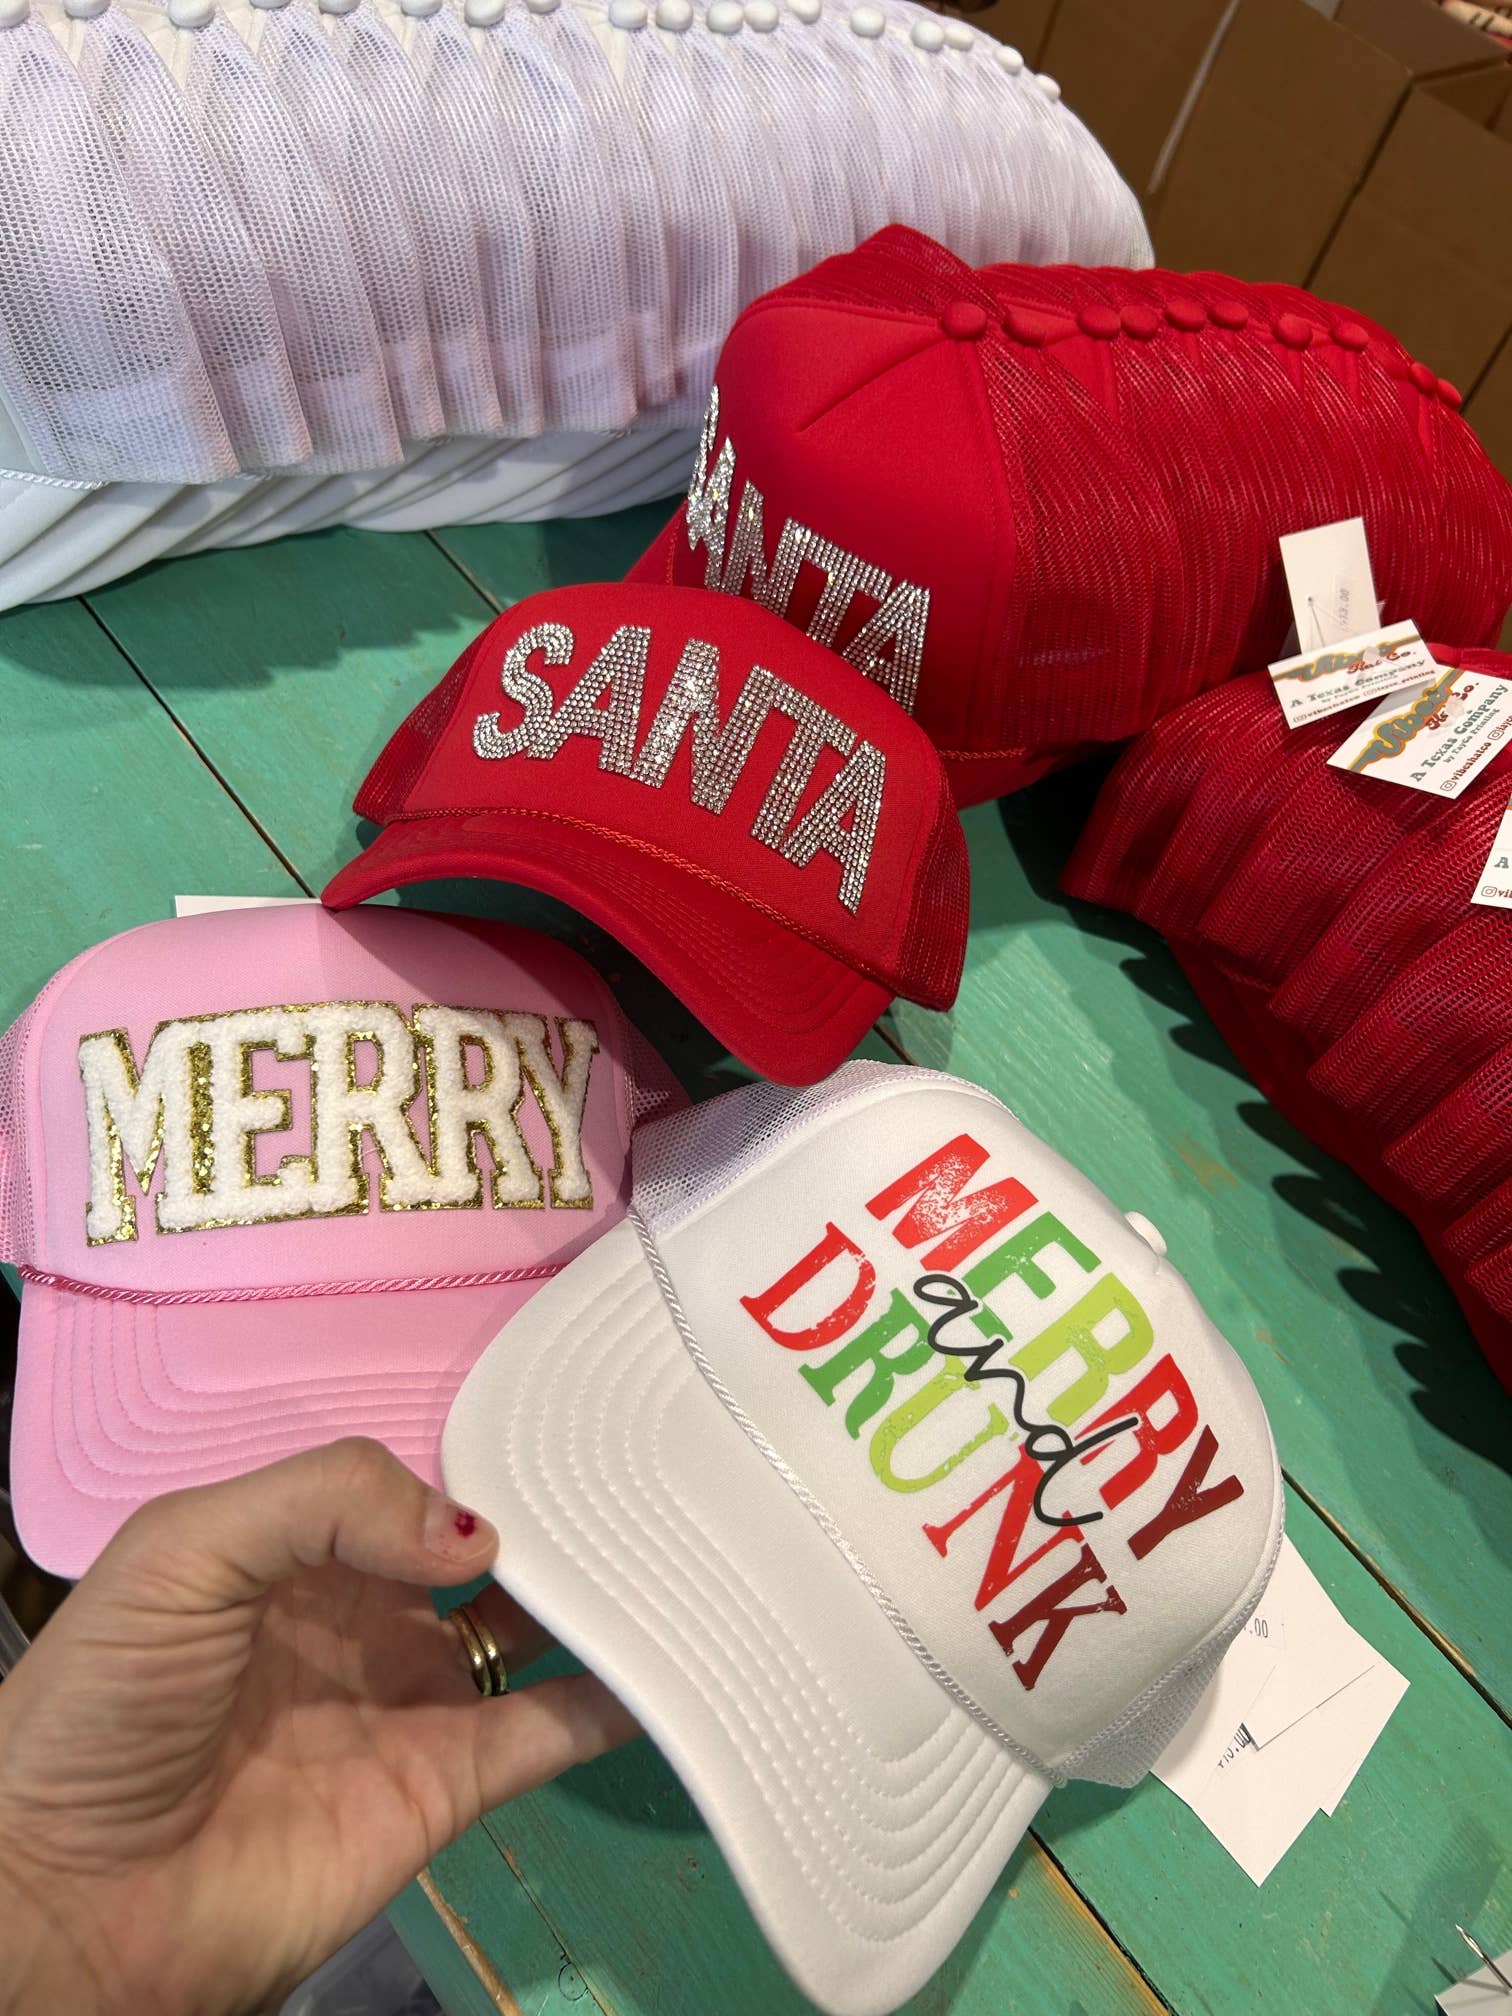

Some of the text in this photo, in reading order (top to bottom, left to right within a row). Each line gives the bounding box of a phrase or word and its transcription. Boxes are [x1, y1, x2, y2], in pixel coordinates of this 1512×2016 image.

[473, 622, 887, 916] SANTA
[1290, 659, 1426, 708] A Texas Company
[1410, 771, 1427, 783] A
[1421, 737, 1458, 768] Texas
[1454, 684, 1509, 735] Company
[1493, 856, 1510, 869] A
[78, 1000, 600, 1247] MERRY
[739, 1221, 1128, 1691] DRUNK
[865, 1133, 1244, 1560] MERRY
[913, 1273, 1103, 1526] and
